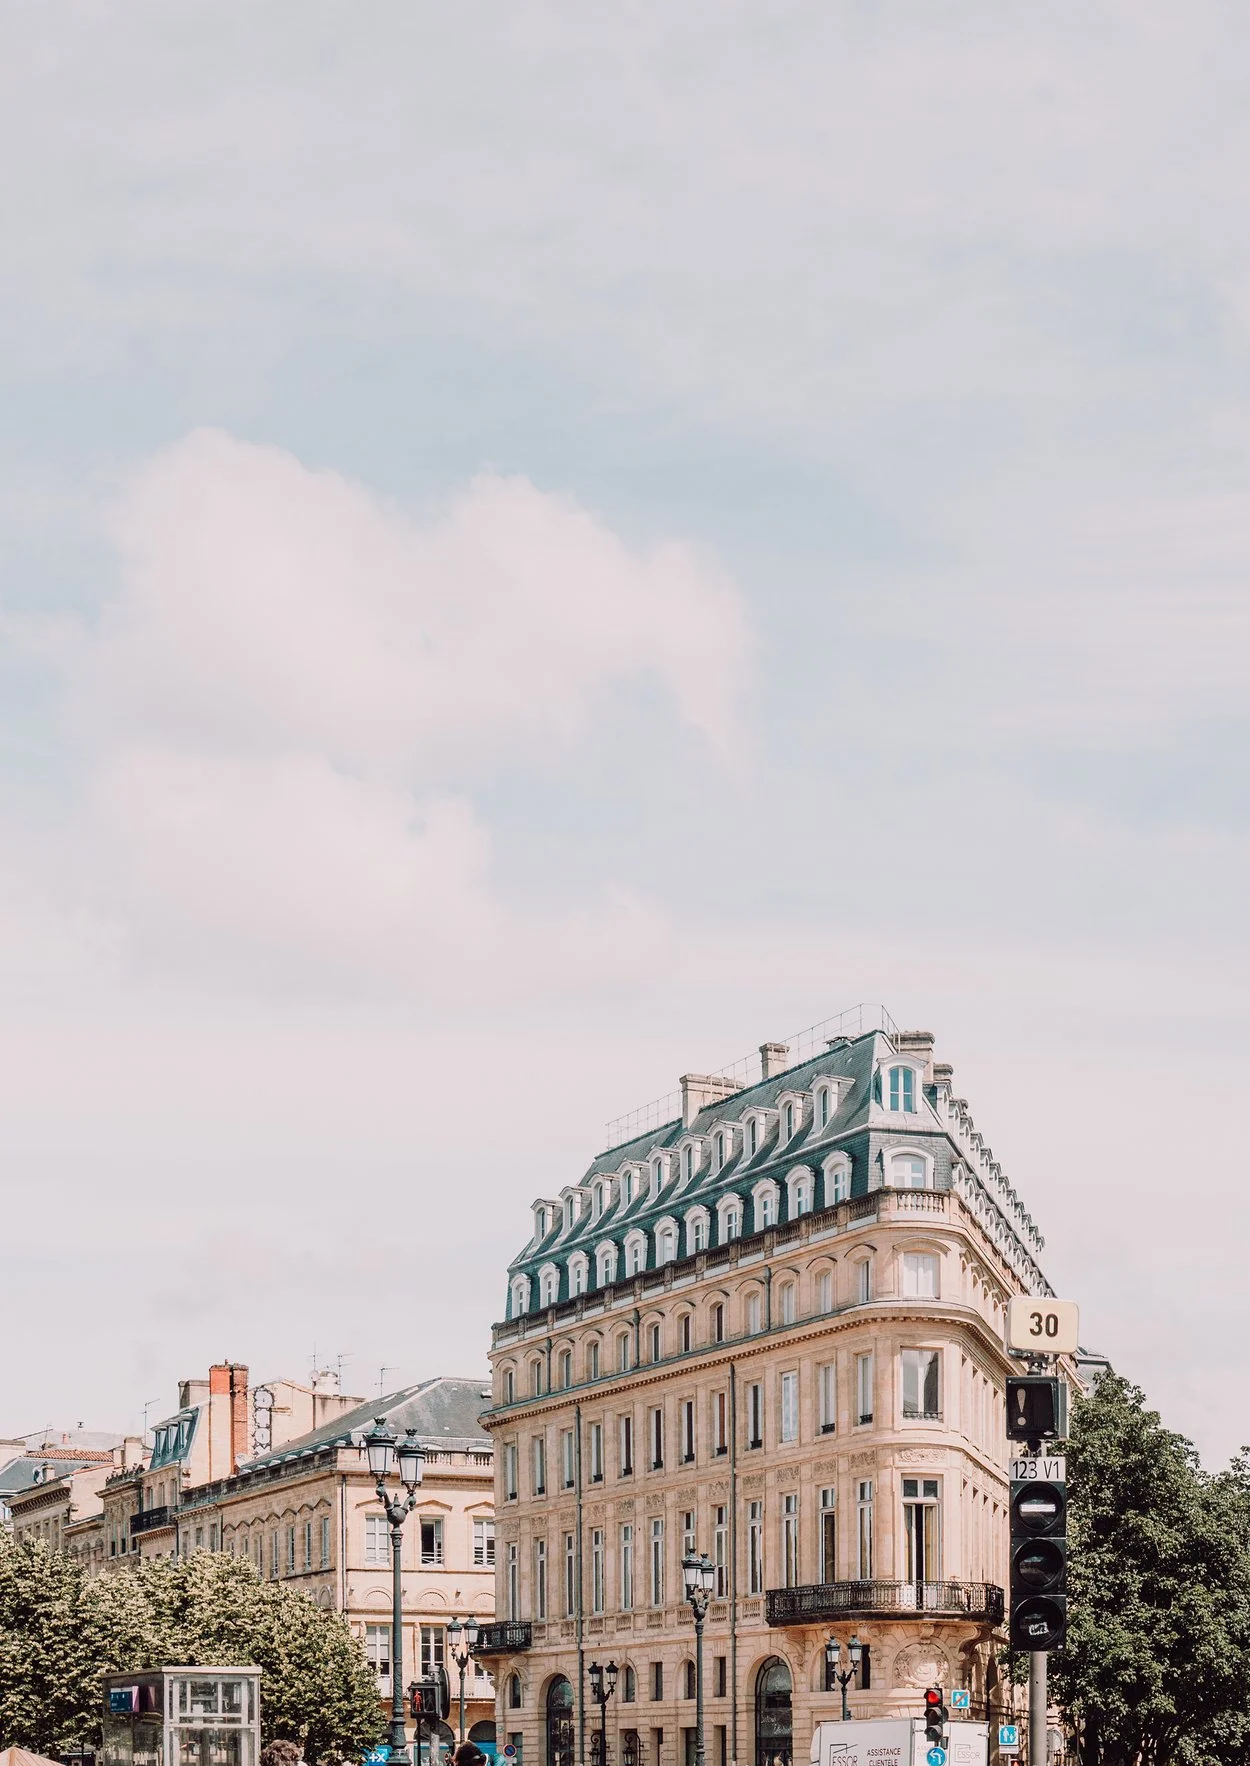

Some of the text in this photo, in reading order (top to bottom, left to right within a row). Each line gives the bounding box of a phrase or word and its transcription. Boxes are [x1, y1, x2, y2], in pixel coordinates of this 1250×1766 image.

[1029, 1311, 1059, 1338] 30
[1012, 1460, 1059, 1480] 123 V1
[867, 1747, 901, 1757] ASSISTANCE
[957, 1750, 980, 1760] ESSOR
